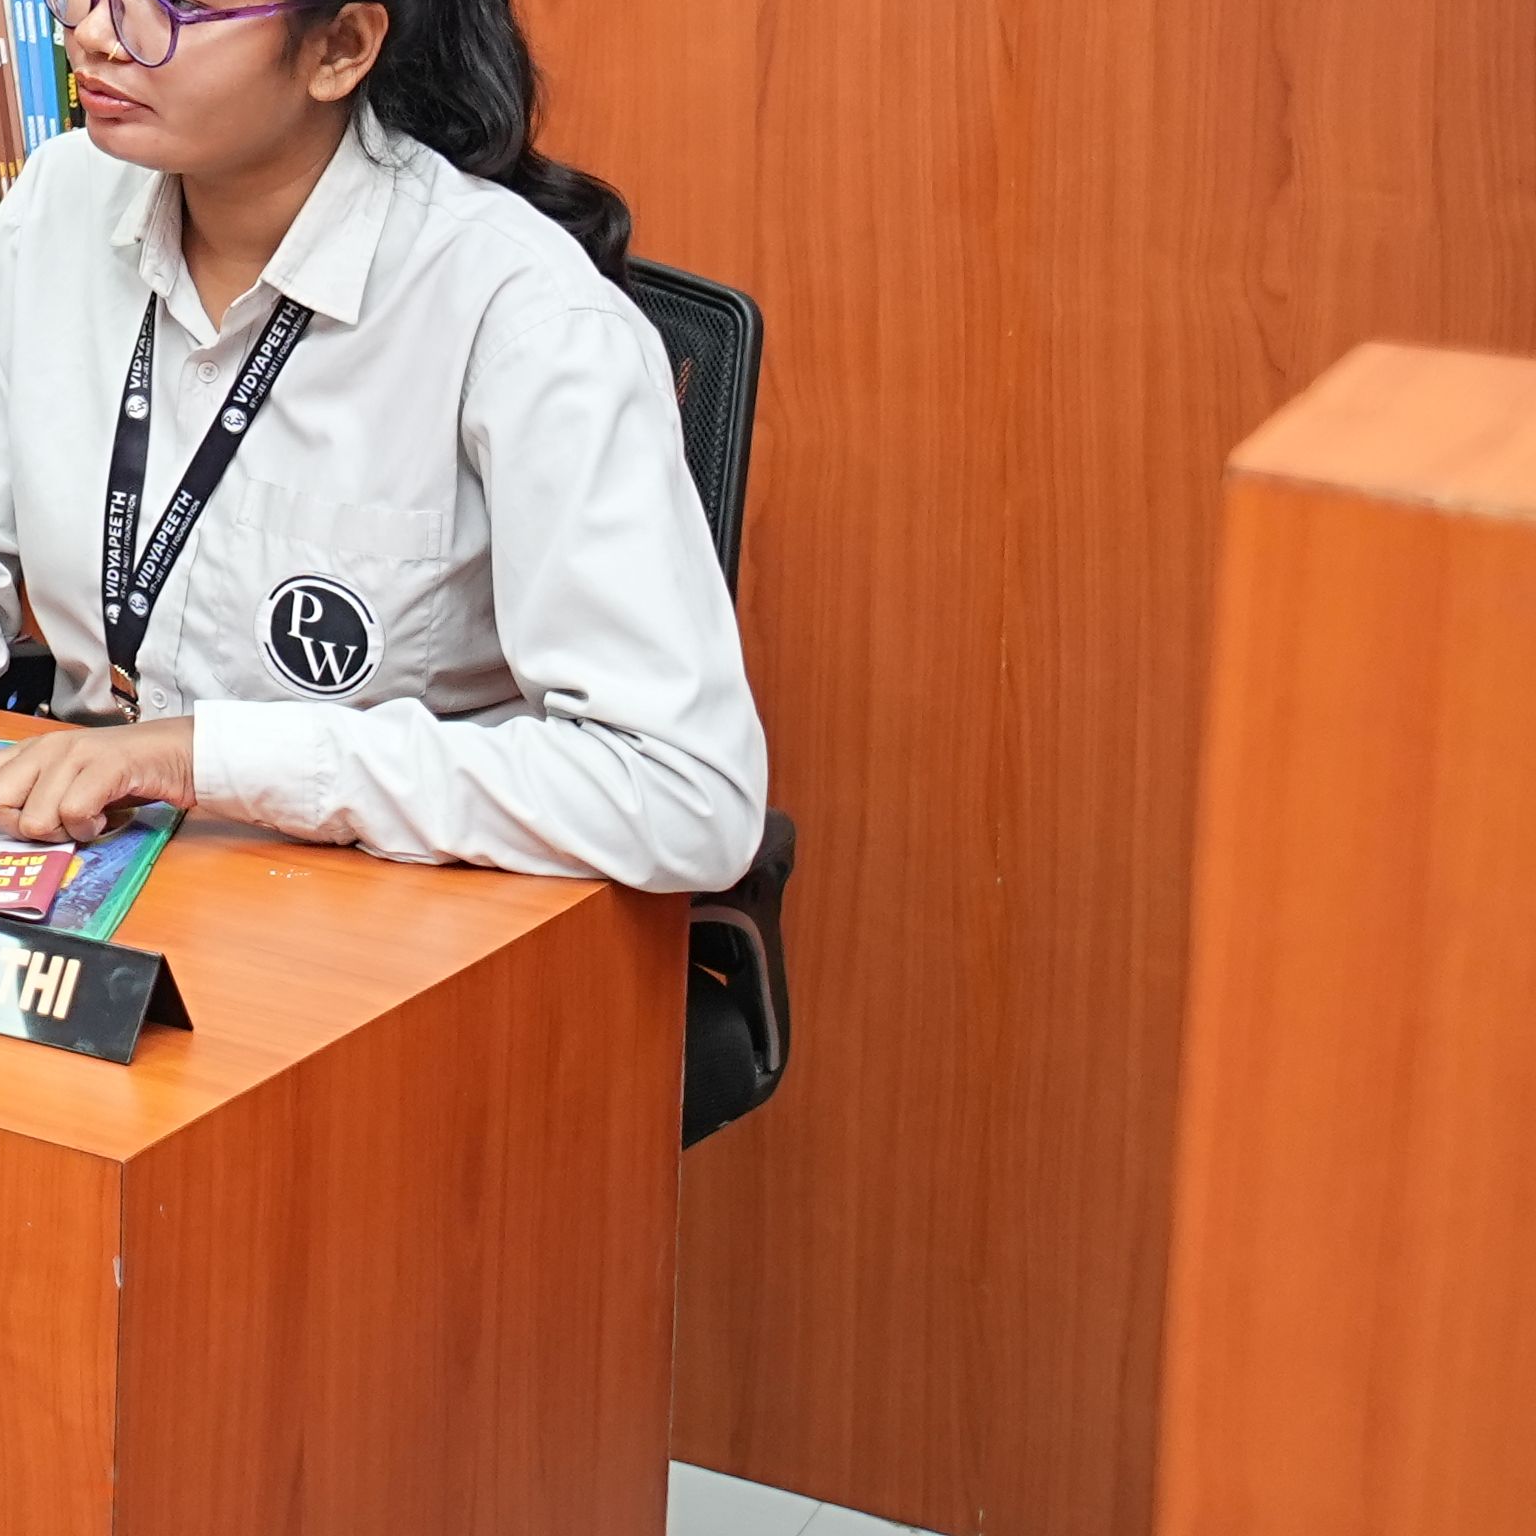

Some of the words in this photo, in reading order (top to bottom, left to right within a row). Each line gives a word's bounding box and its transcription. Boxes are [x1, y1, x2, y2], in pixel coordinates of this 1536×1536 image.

[232, 302, 300, 405] VIDYAPEETH
[278, 310, 309, 359] FOUNDATION
[106, 490, 127, 598] VIDYAPEETH
[135, 489, 193, 590] VIDYAPEETH
[173, 499, 201, 545] FOUNDATION
[287, 589, 358, 684] PW
